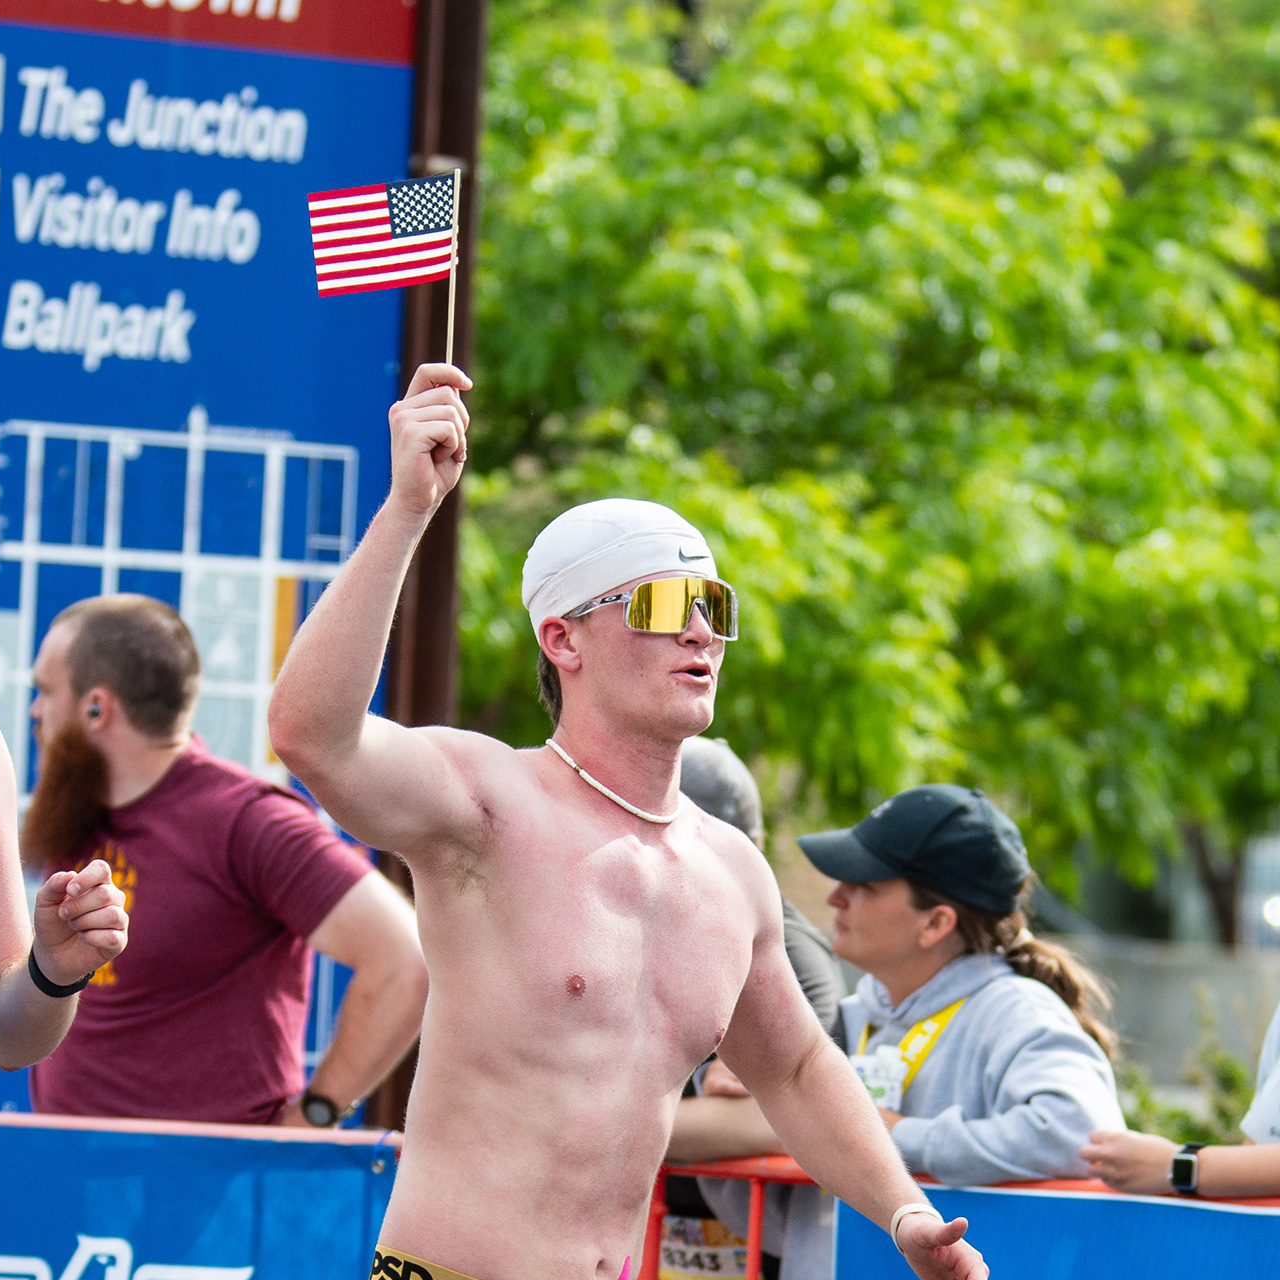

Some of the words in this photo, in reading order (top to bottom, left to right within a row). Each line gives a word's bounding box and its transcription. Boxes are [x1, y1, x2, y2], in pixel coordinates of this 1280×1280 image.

[18, 66, 106, 142] The
[106, 78, 308, 164] Junction
[12, 172, 165, 257] Visitor
[166, 188, 261, 264] Info
[2, 279, 197, 372] Ballpark
